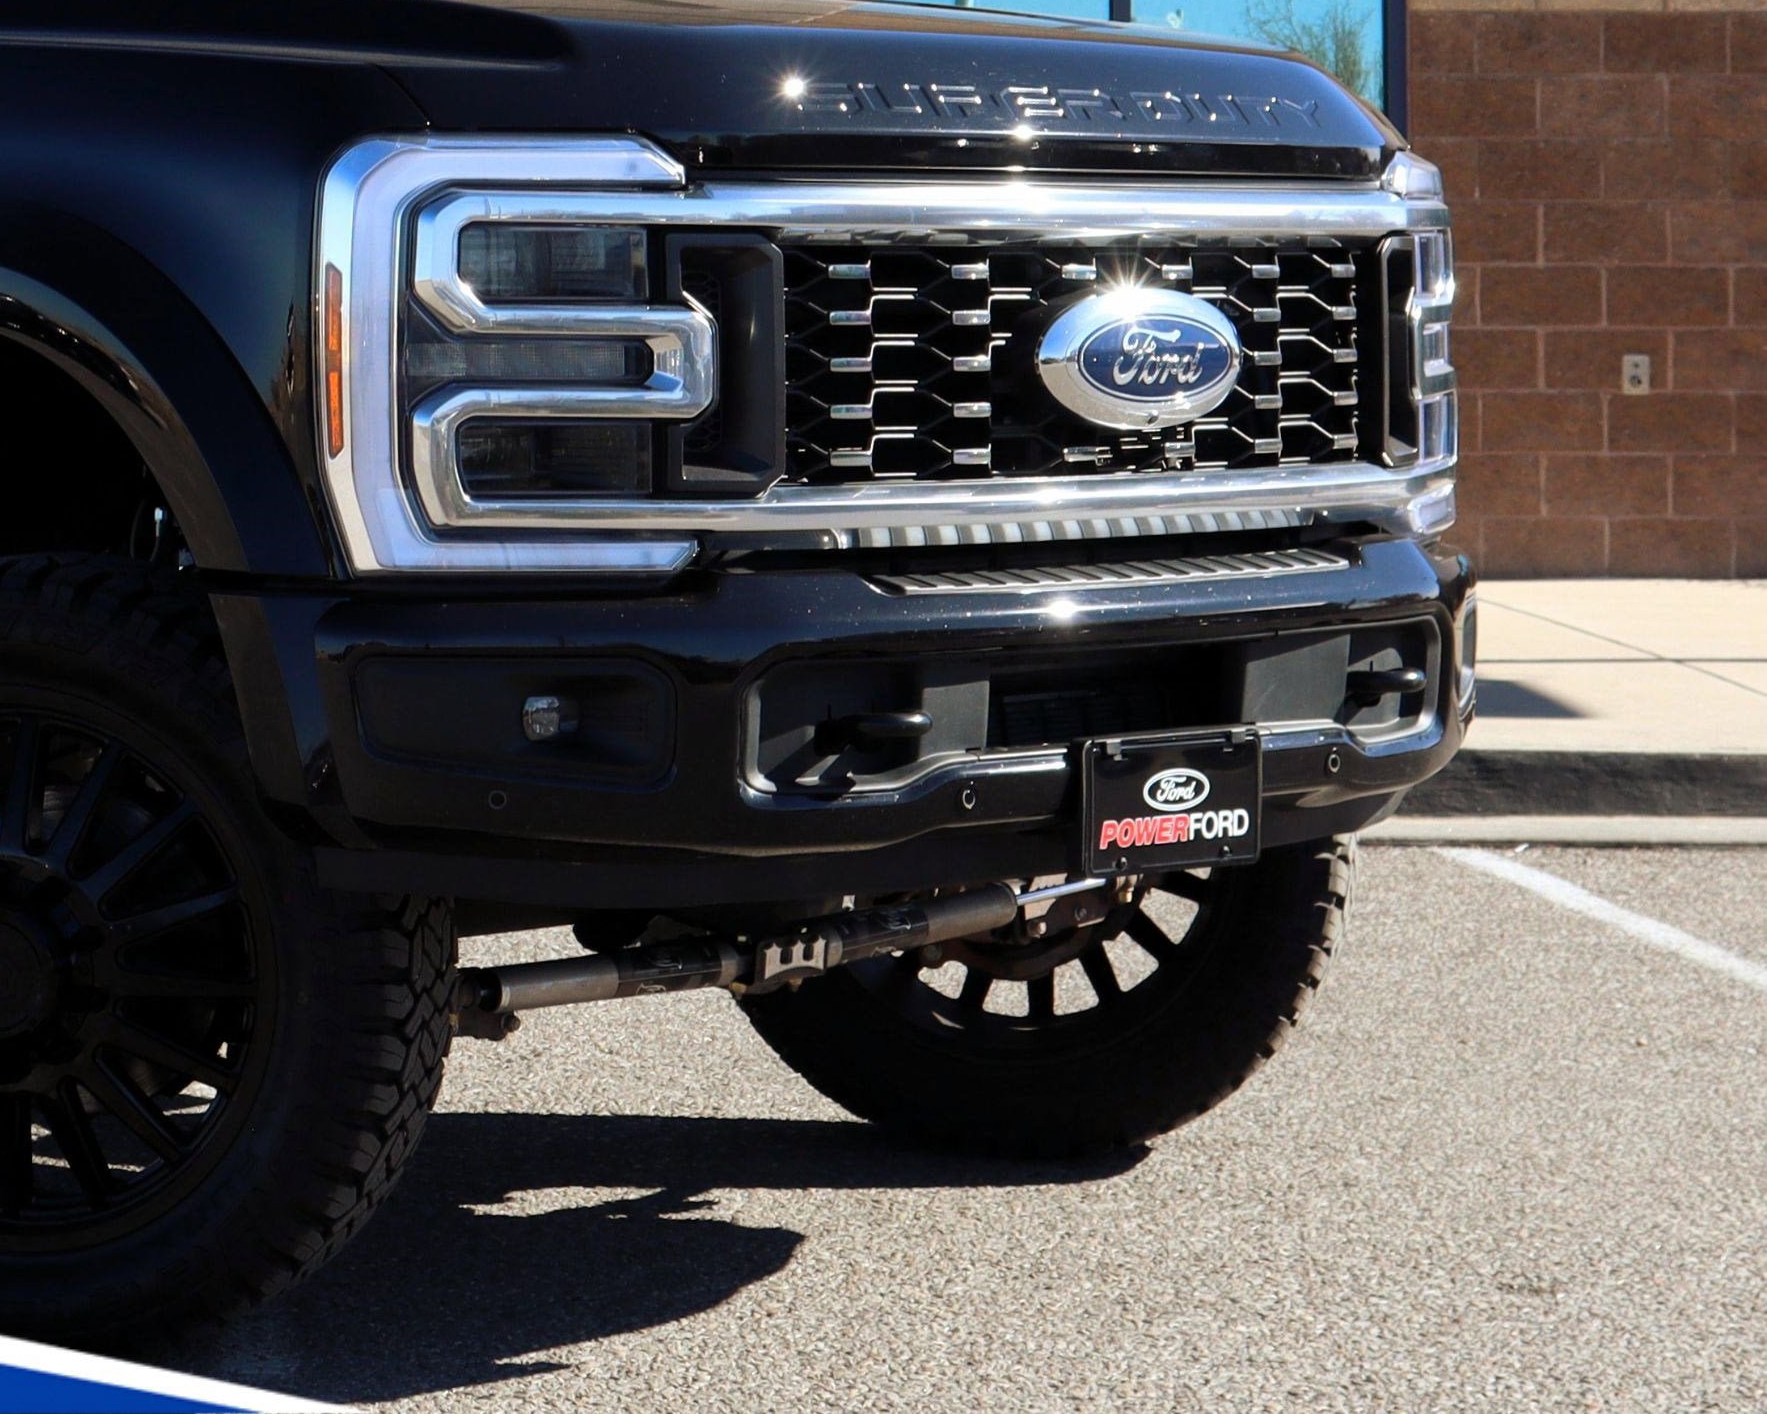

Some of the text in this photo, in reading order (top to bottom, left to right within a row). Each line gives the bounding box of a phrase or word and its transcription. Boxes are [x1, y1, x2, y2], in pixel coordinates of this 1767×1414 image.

[785, 82, 1322, 129] SUPER DUTY
[1112, 324, 1204, 386] Ford
[1156, 776, 1197, 803] Ford
[1099, 808, 1250, 850] POWERFORD
